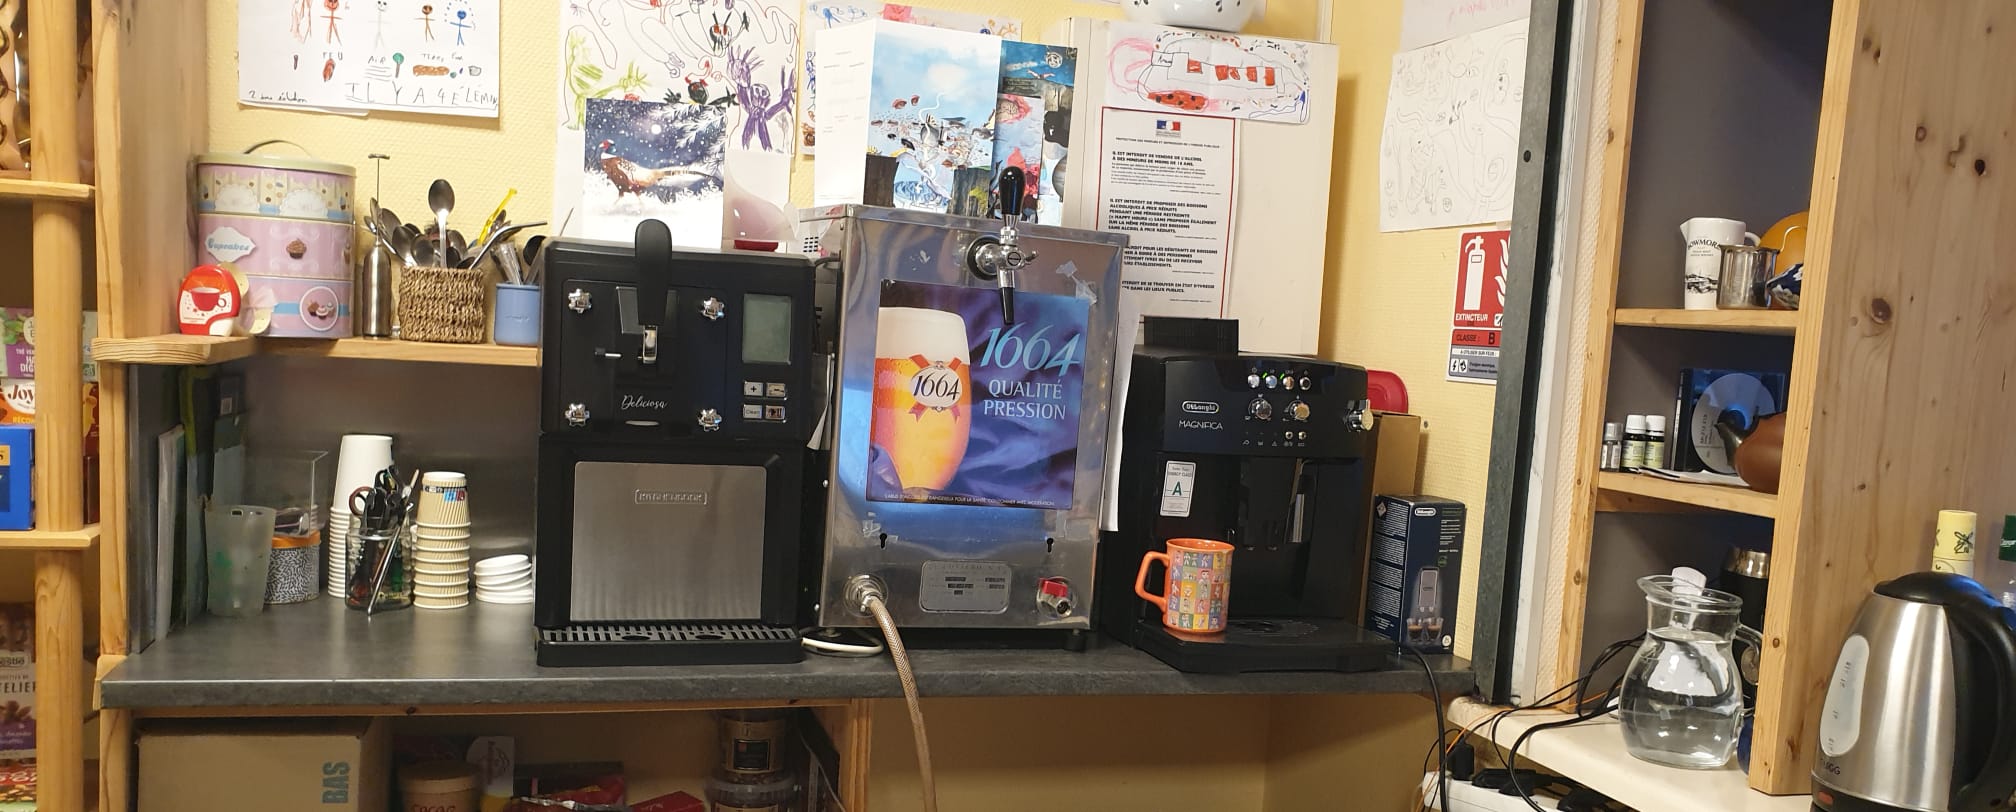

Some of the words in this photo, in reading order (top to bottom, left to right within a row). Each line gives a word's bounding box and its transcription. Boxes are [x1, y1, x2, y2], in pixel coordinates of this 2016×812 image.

[413, 87, 425, 104] A
[1488, 332, 1495, 344] B
[980, 322, 1081, 377] 1664
[913, 371, 960, 401] 1664
[988, 379, 1062, 400] QUALITÉ
[620, 394, 668, 410] Deliciosa
[984, 400, 1066, 420] PRESSION
[1178, 420, 1223, 431] MAGNIFICA
[1172, 482, 1182, 496] A
[322, 761, 350, 804] BAS
